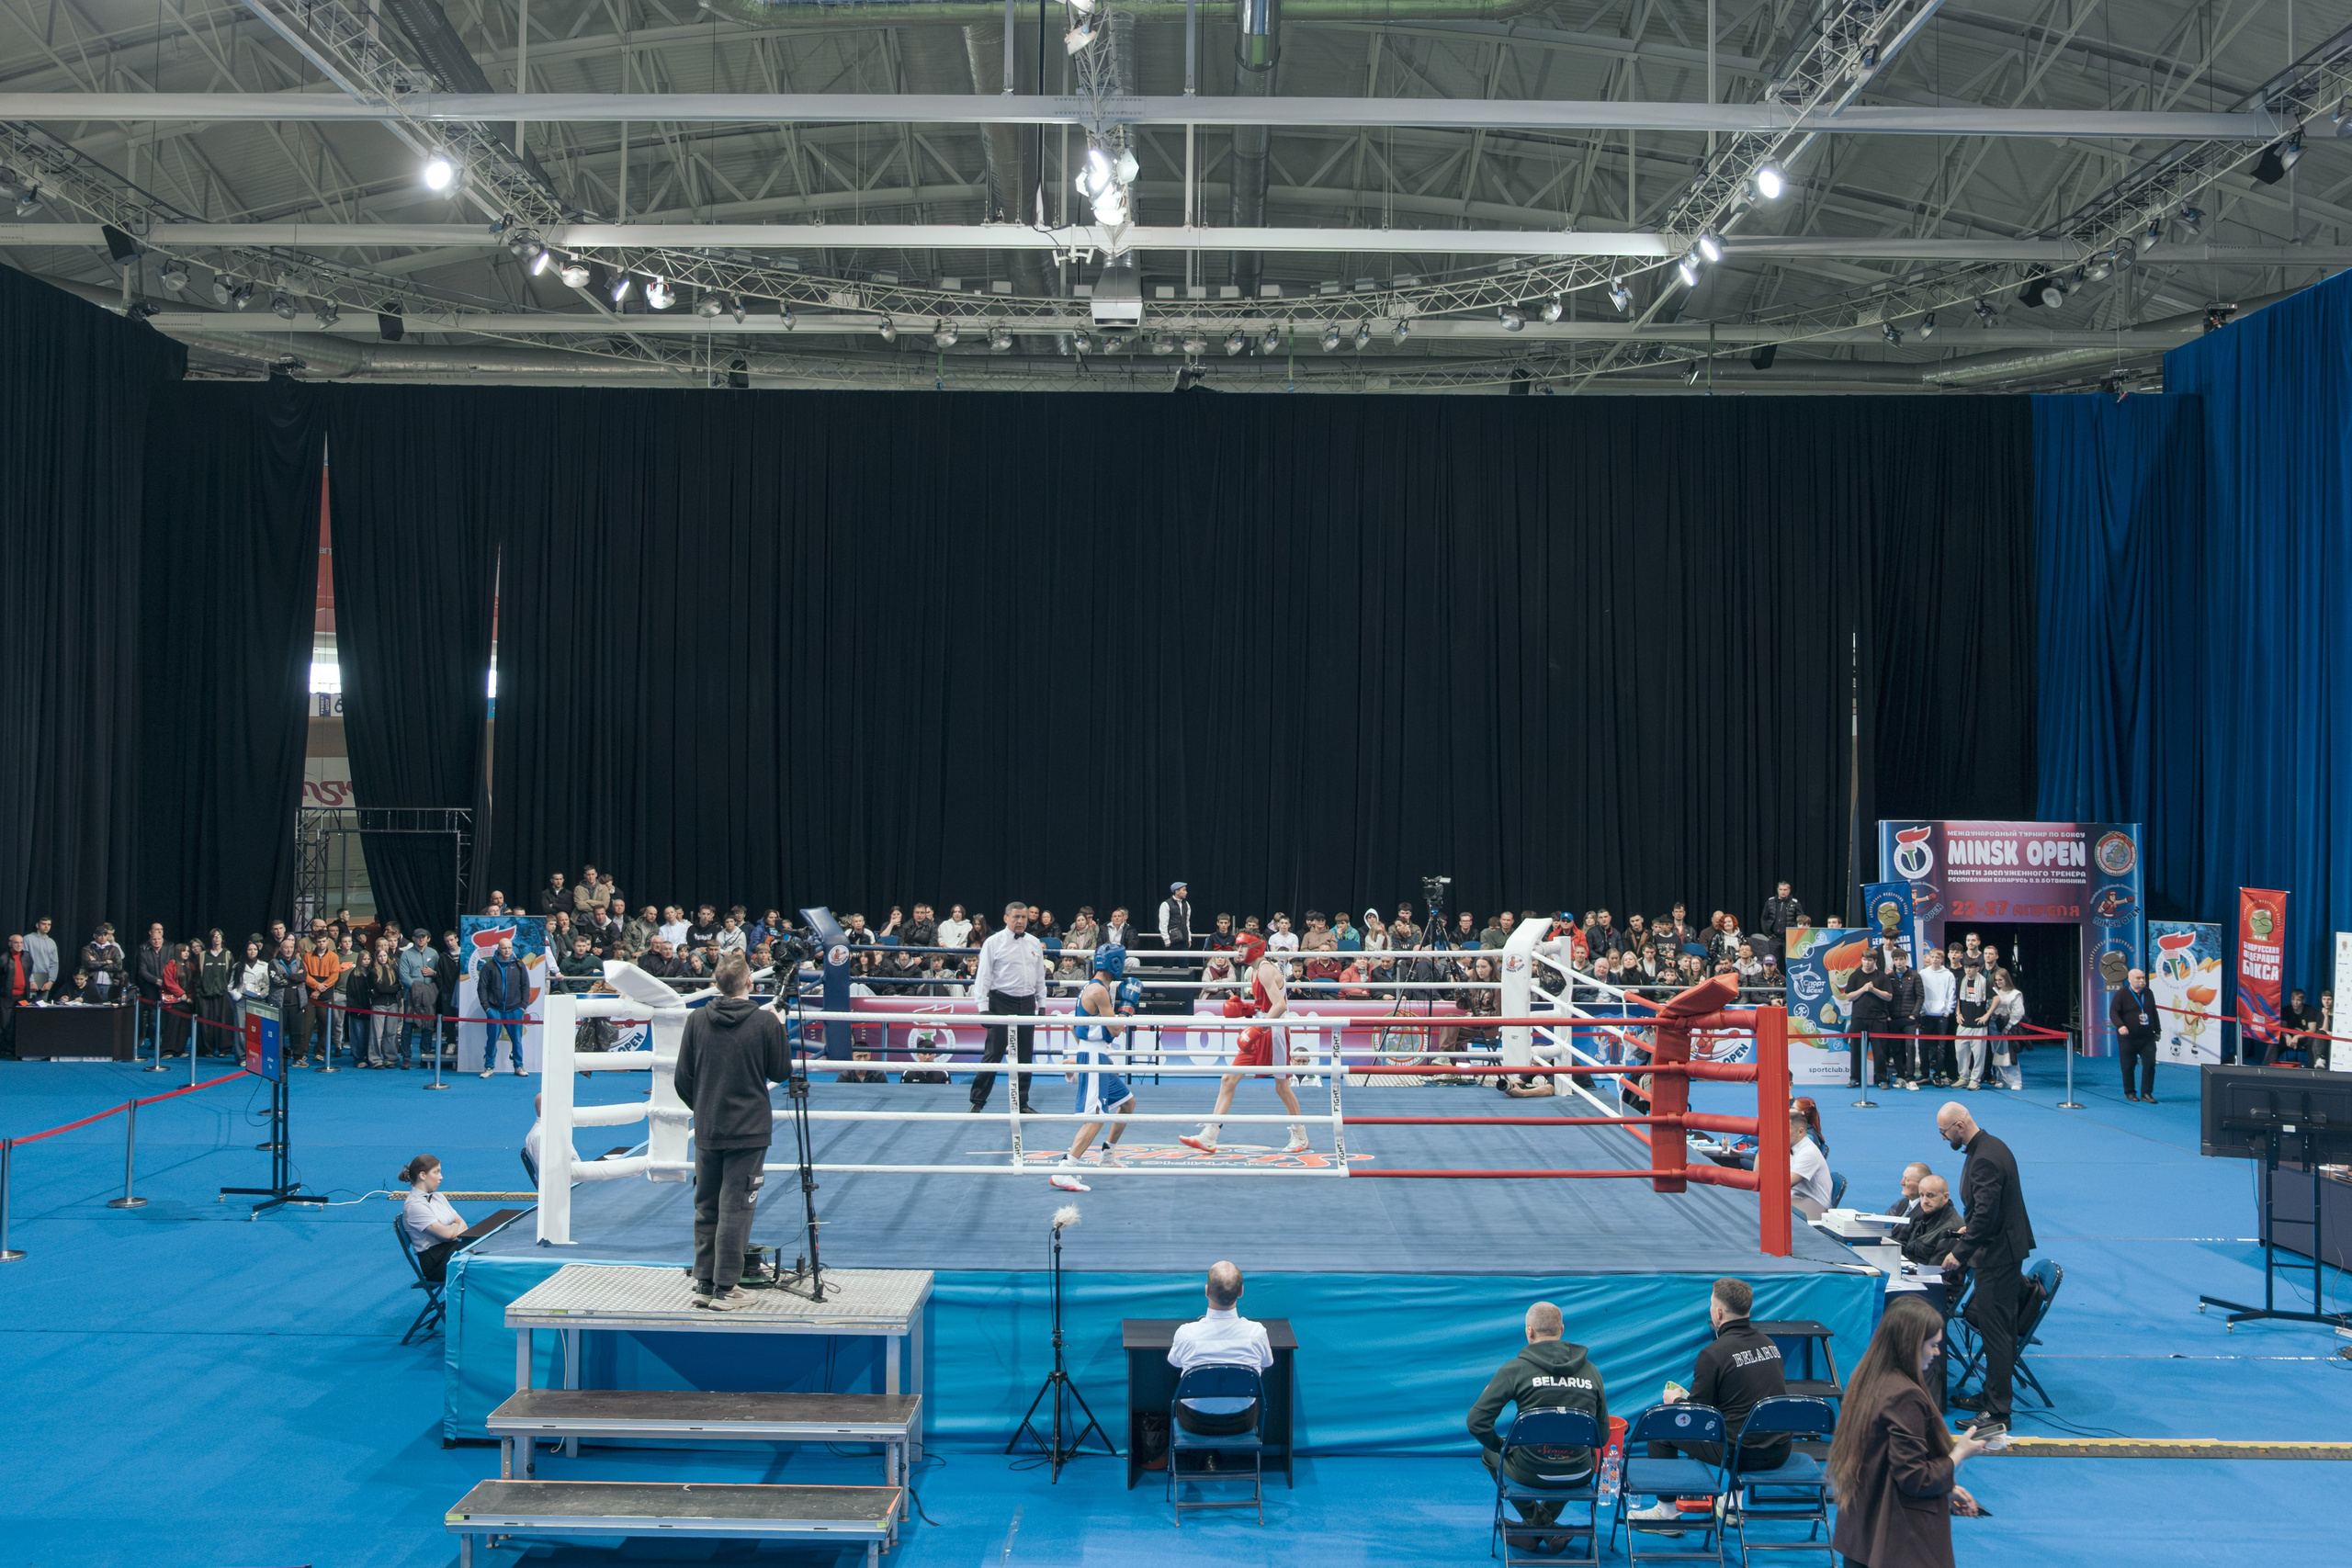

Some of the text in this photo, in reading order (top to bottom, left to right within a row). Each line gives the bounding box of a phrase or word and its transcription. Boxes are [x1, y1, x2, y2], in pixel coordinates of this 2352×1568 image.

[1948, 840, 2019, 866] MINSK
[2026, 840, 2086, 867] OPEN
[1923, 903, 1943, 922] OPEN
[1952, 900, 2080, 917] 22-27 АПРЕЛЯ
[2093, 906, 2142, 928] MINSK OPEN
[1723, 1043, 1749, 1064] OPEN
[1337, 1142, 1345, 1166] FIGHT
[1532, 1375, 1593, 1390] BELARUS
